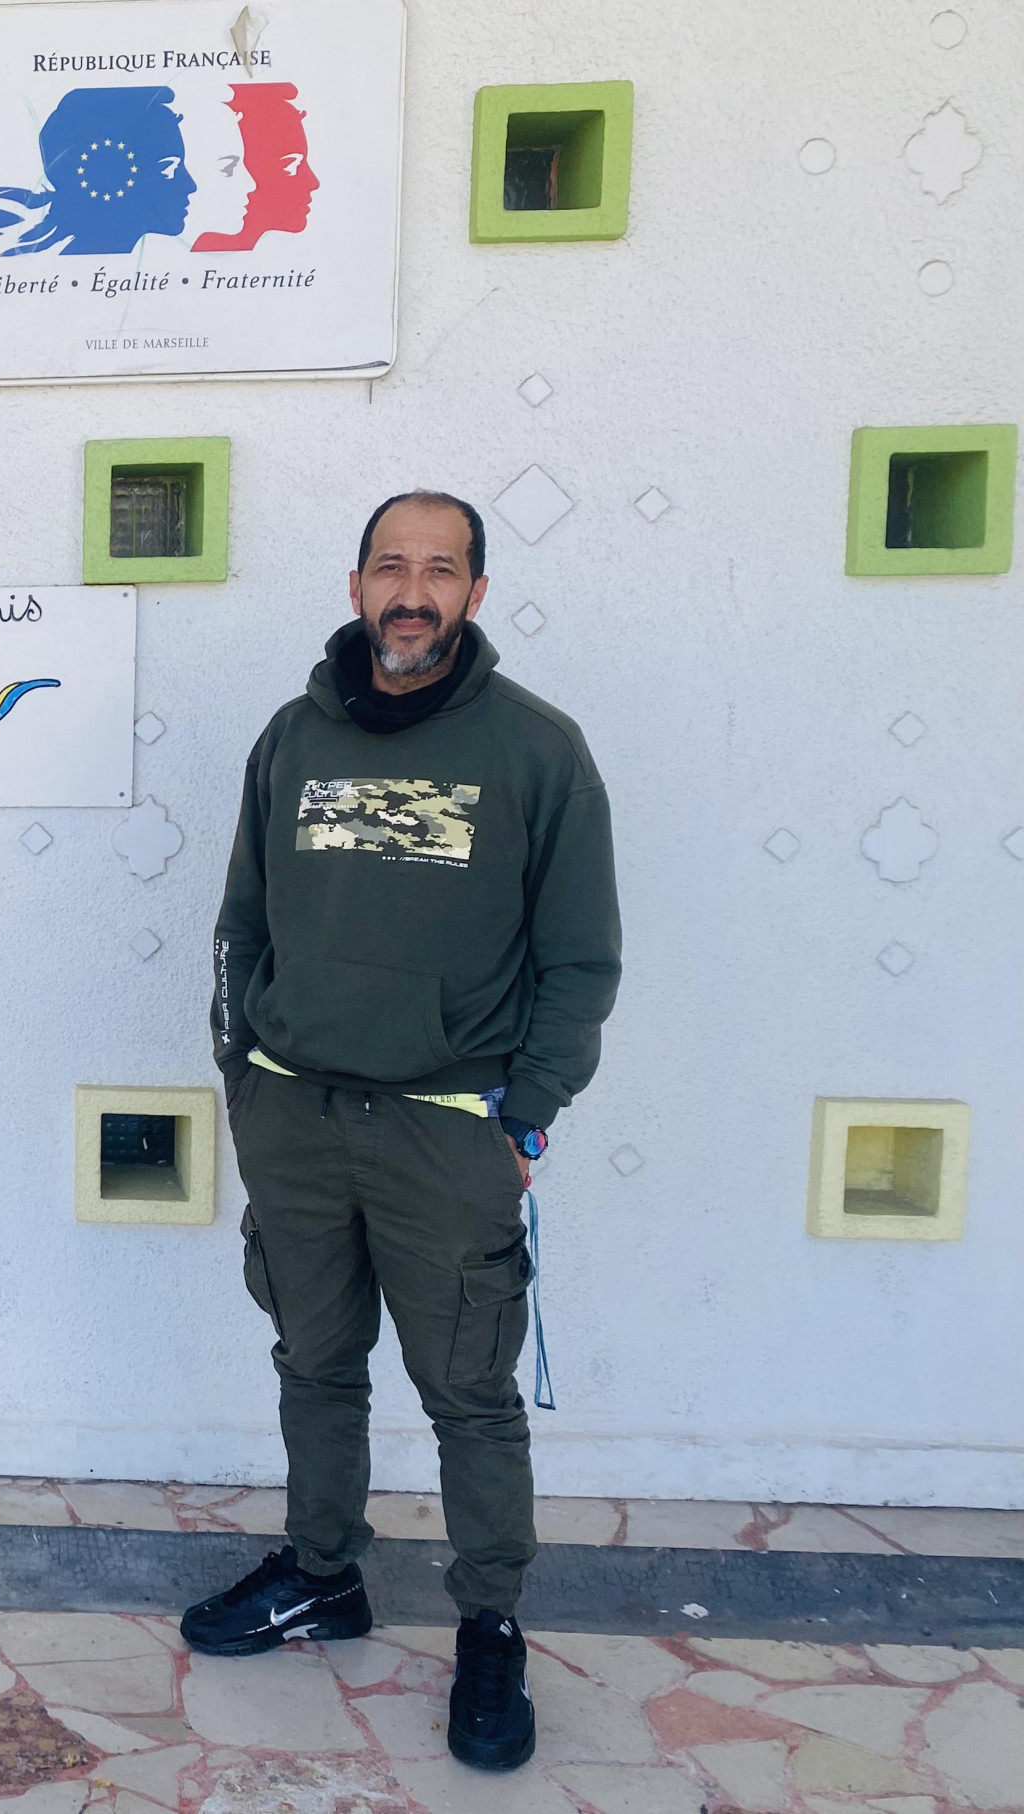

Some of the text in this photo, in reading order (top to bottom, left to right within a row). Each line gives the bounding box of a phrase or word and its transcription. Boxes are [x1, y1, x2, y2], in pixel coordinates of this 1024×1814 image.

[33, 51, 156, 73] RÉPUBLIQUE
[90, 267, 170, 298] Égalité
[201, 269, 316, 291] Fraternité
[85, 337, 210, 350] VILLE DE MARSEILLE
[303, 789, 356, 798] CULTURE
[446, 860, 469, 868] RULES
[219, 940, 230, 999] CULTURE
